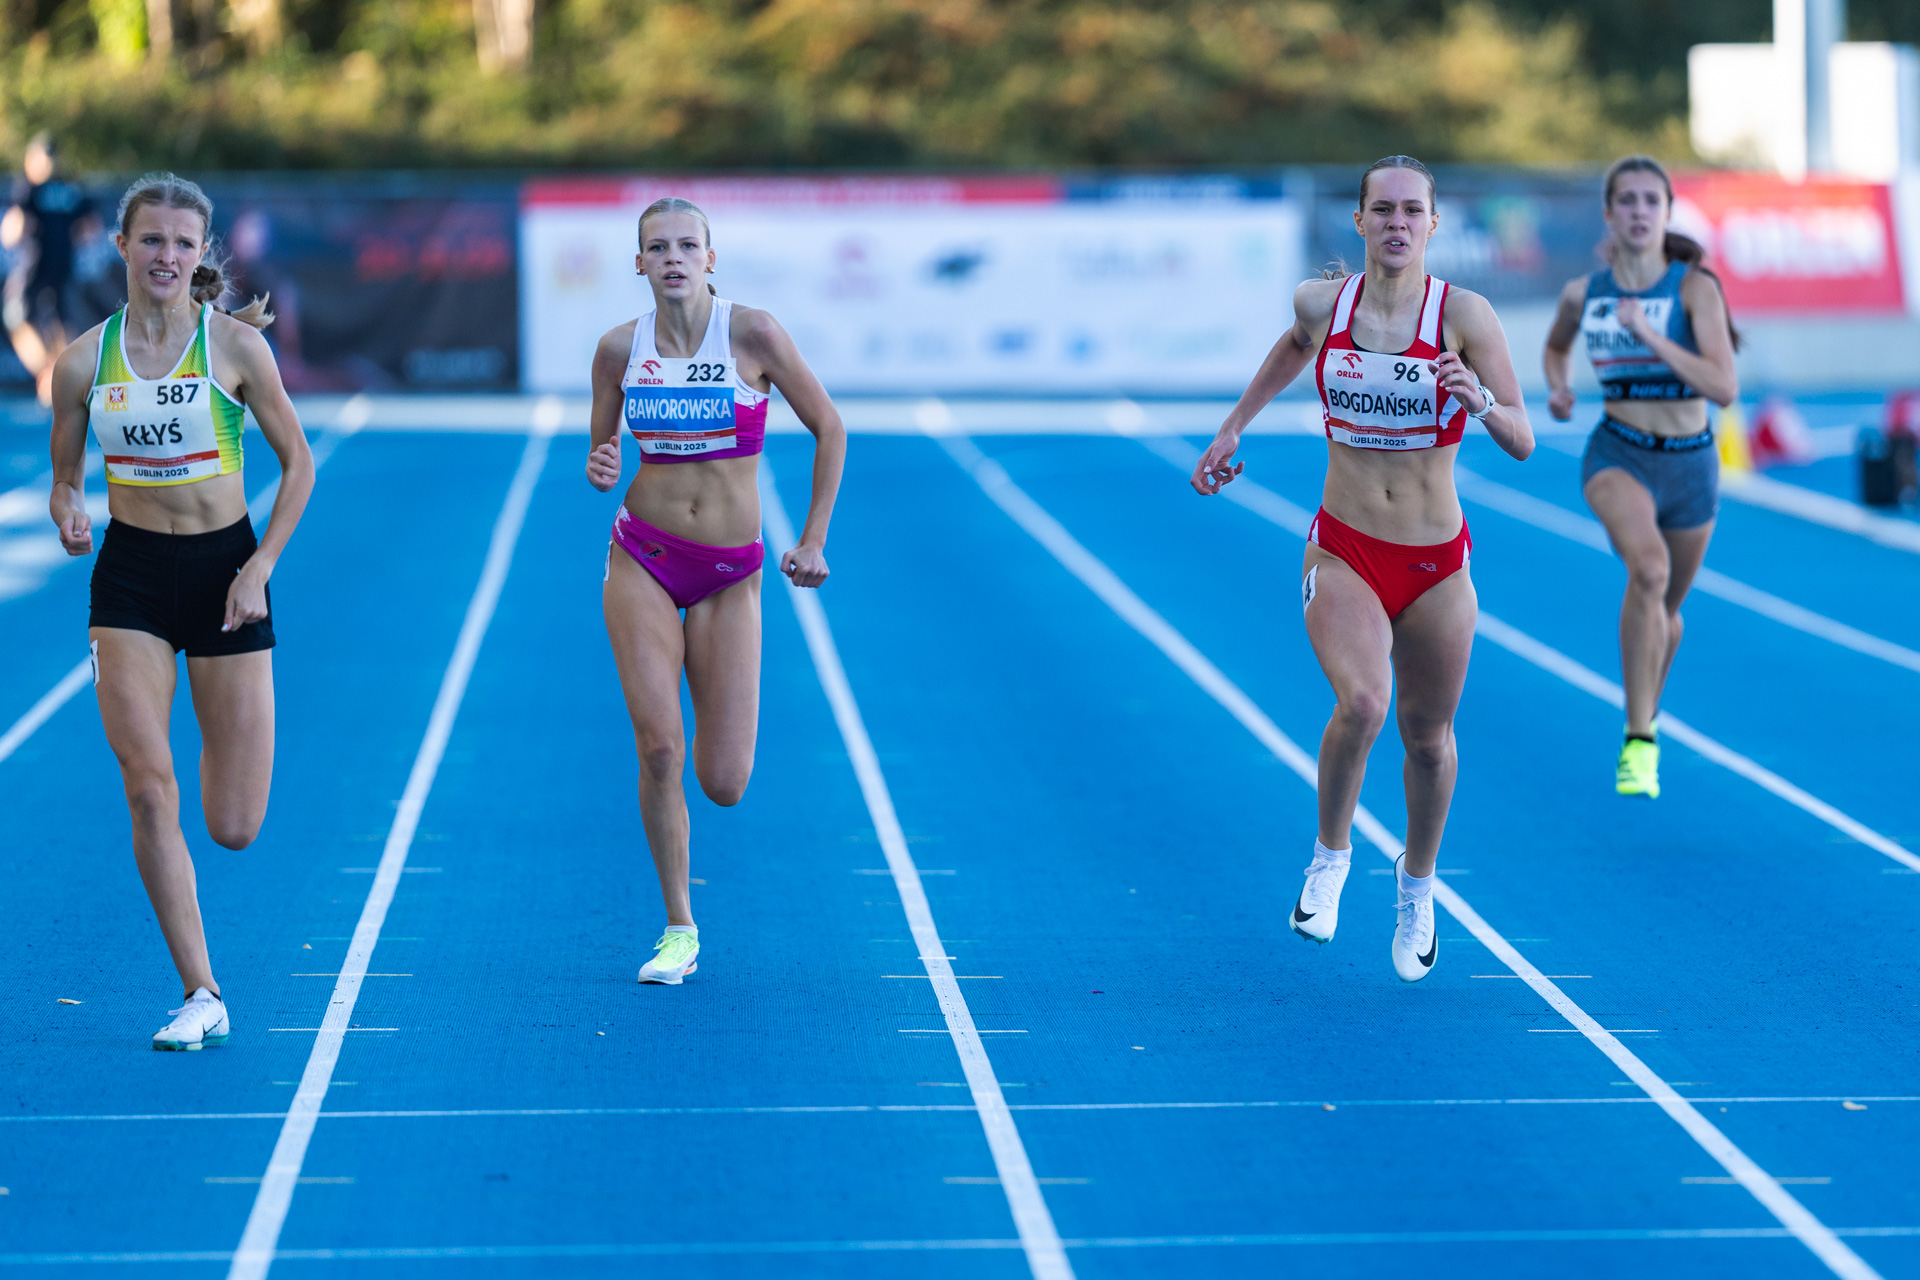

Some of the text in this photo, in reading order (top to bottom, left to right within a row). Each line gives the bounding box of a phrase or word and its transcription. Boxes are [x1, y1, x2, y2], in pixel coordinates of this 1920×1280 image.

[686, 363, 725, 382] 232
[1336, 370, 1363, 380] ORLEN
[1393, 362, 1420, 383] 96
[157, 383, 199, 405] 587
[1629, 383, 1681, 399] NIKE
[628, 398, 732, 420] BAWOROWSKA
[1328, 387, 1433, 417] BOGDAŃSKA
[122, 417, 183, 446] KŁYŚ
[1350, 435, 1407, 446] LUBLIN 2025
[655, 442, 707, 451] LUBLIN 2025
[133, 467, 190, 478] LUBLIN 2025
